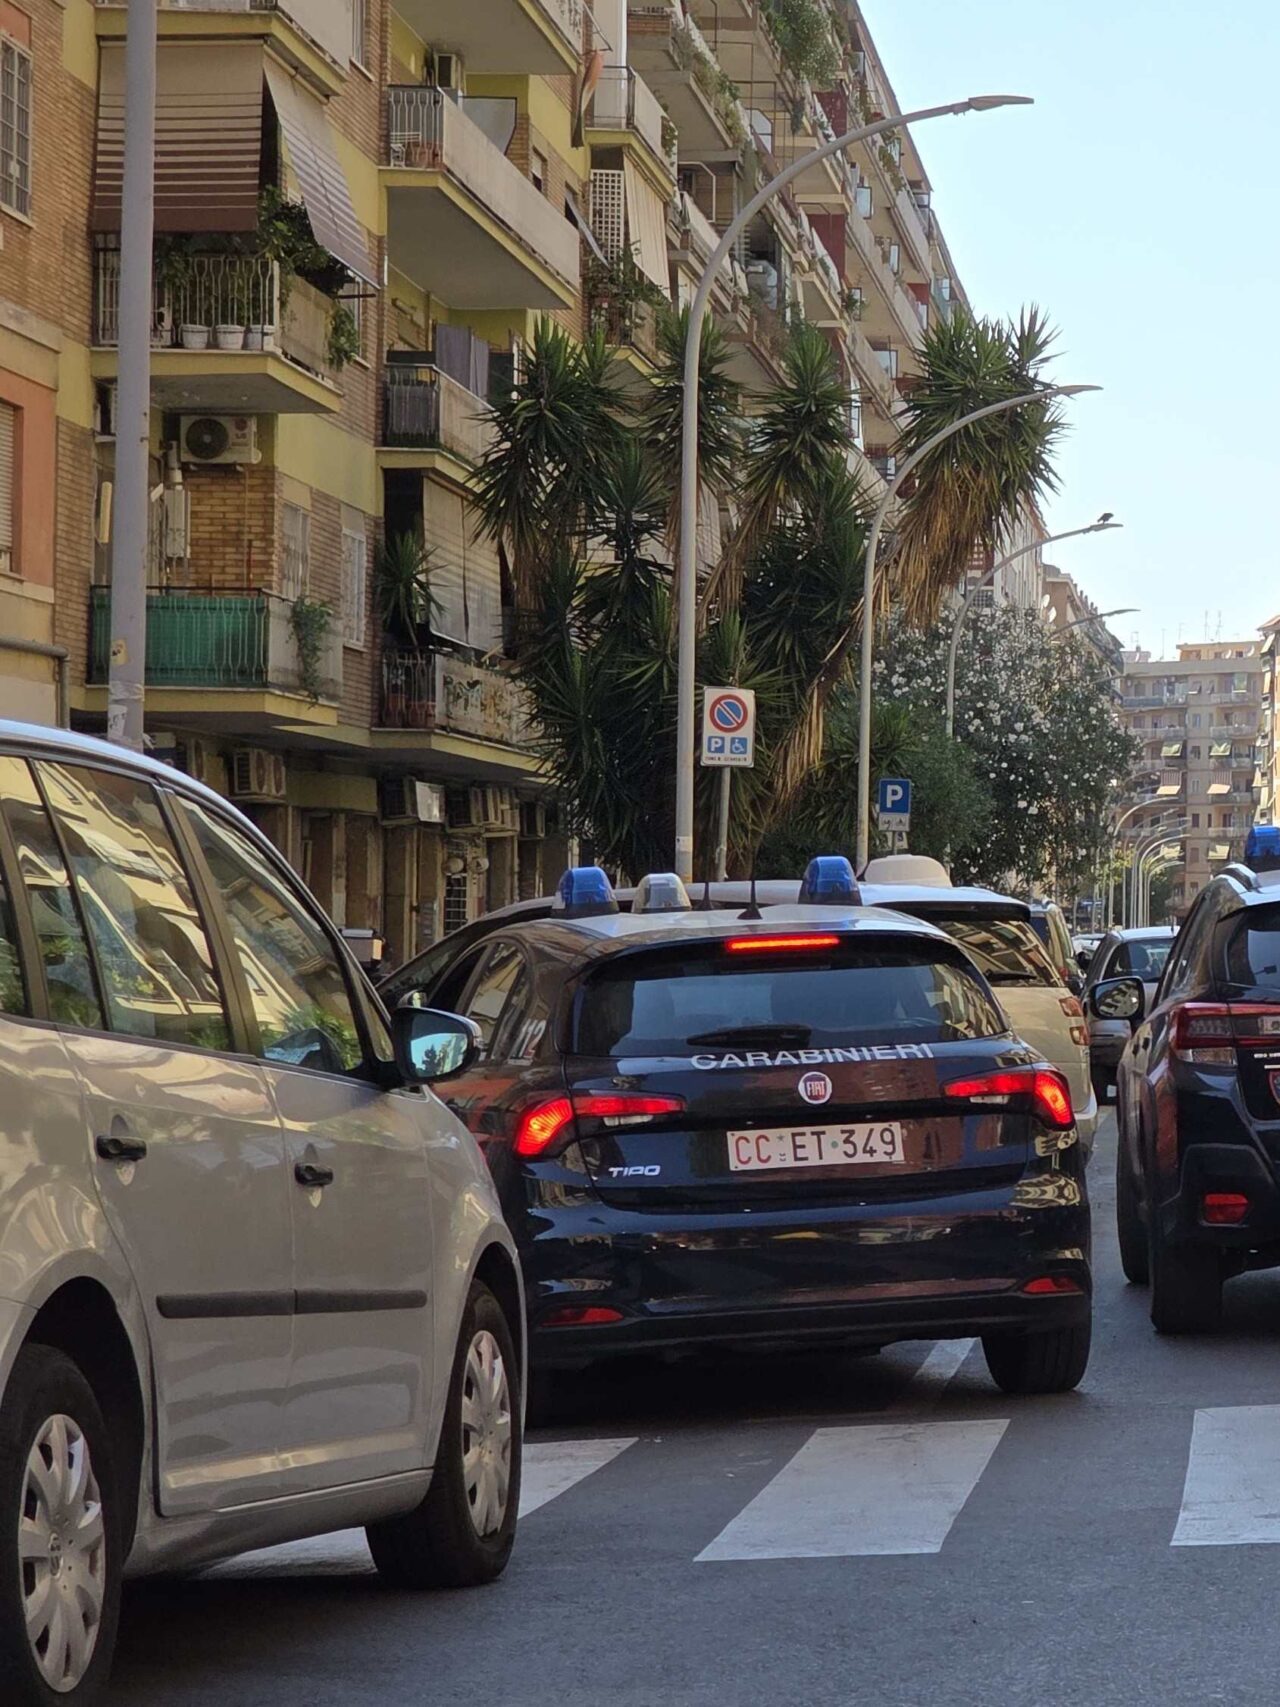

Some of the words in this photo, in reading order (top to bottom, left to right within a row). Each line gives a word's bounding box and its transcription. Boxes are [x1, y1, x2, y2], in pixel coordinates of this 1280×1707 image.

[710, 738, 722, 751] P
[886, 784, 903, 809] P
[690, 1043, 934, 1070] CARABINIERI
[806, 1080, 826, 1096] FIAT
[735, 1134, 772, 1165] CC
[791, 1130, 827, 1161] ET
[839, 1127, 897, 1159] 349
[608, 1164, 661, 1178] TIPO
